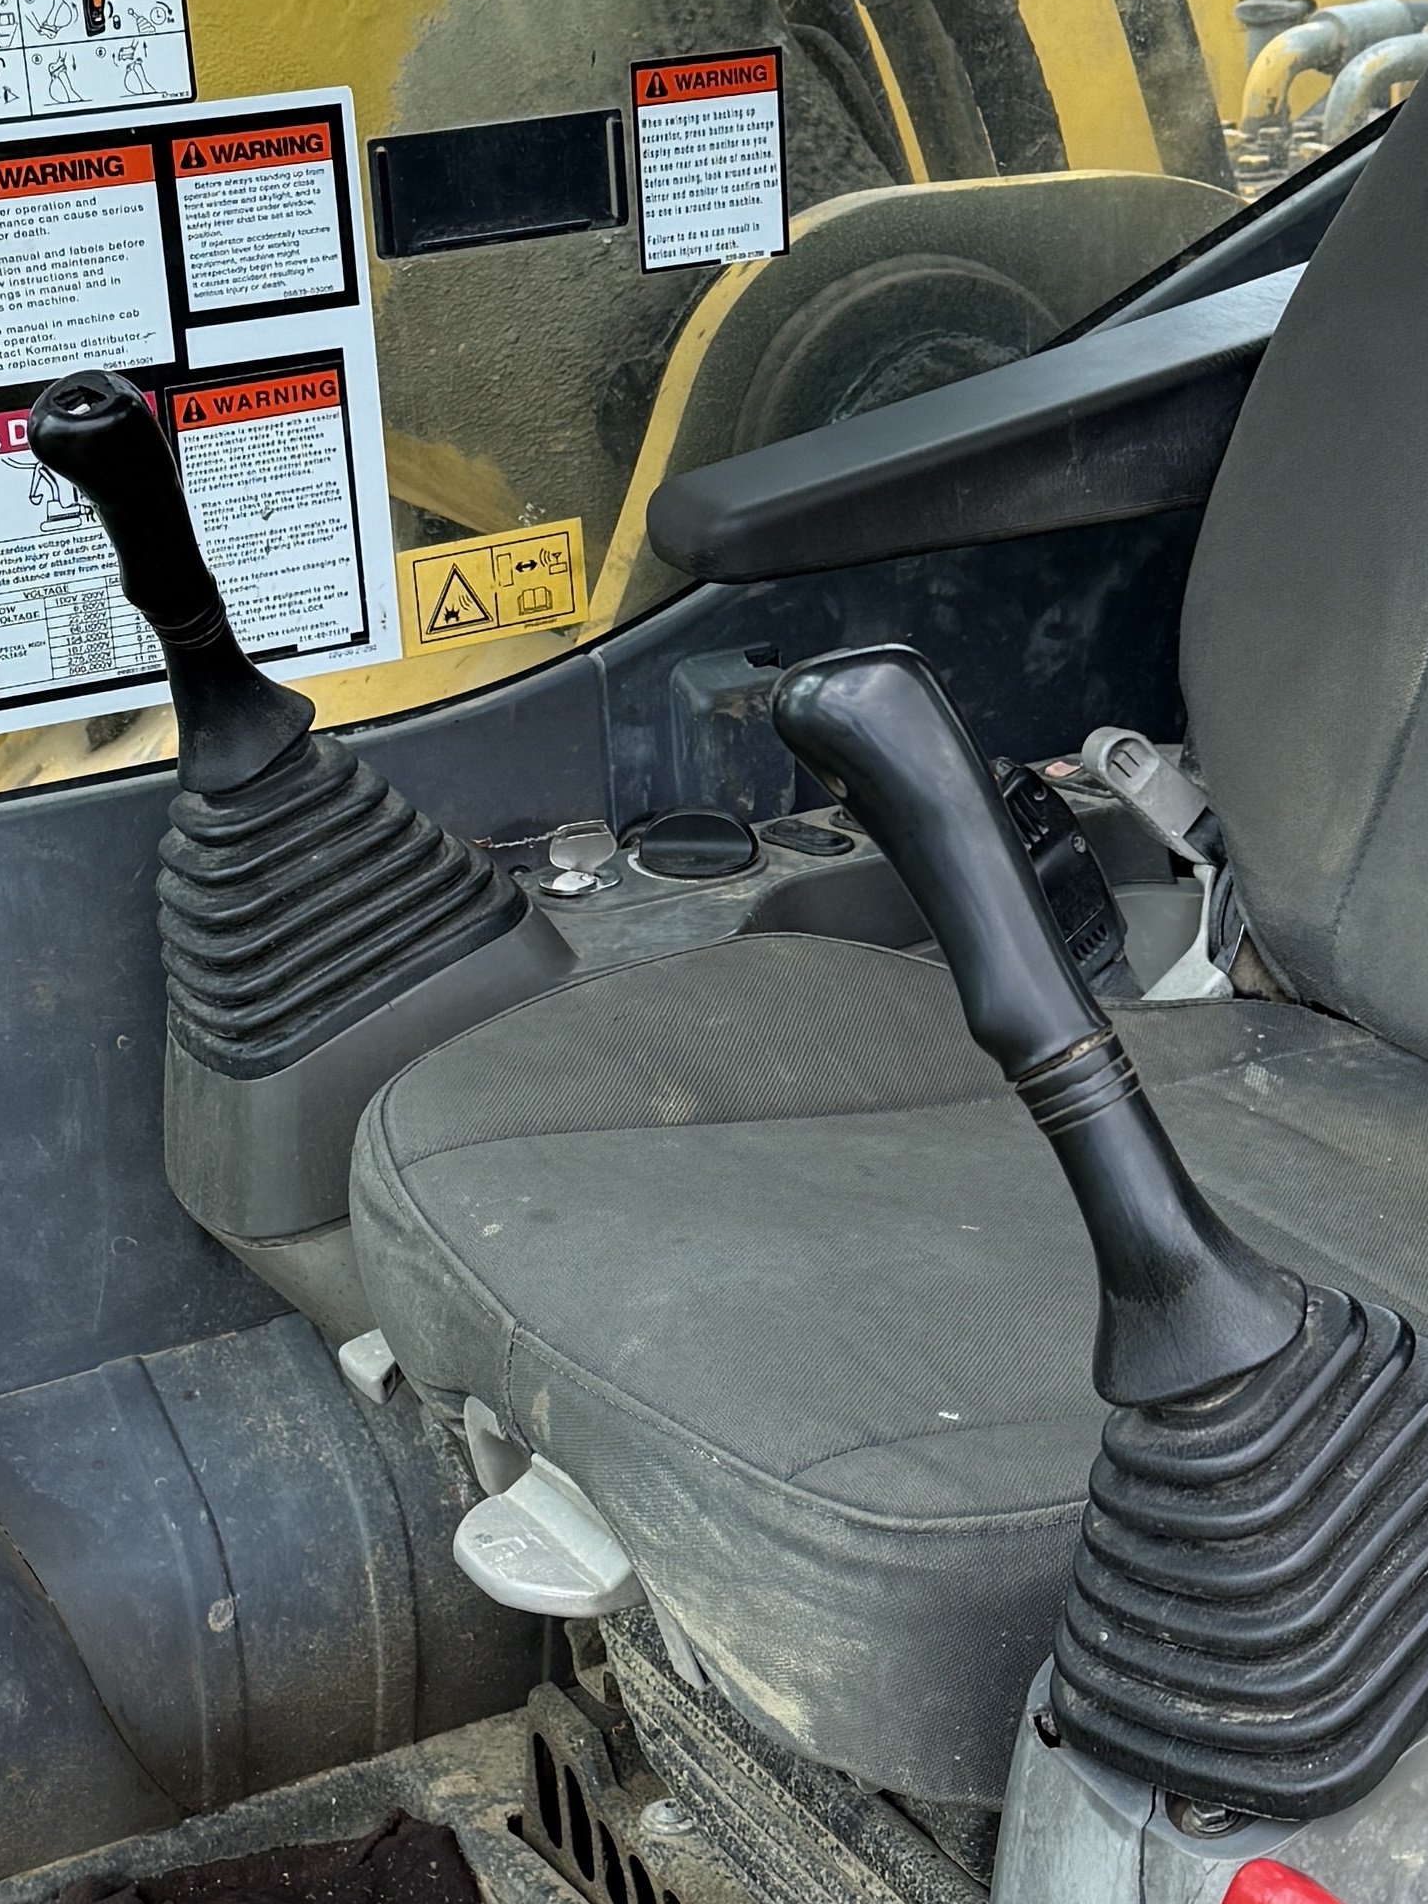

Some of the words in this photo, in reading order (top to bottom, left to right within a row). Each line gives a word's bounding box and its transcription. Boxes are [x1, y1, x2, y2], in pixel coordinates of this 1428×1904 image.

[675, 65, 767, 91] WARNING
[210, 134, 324, 164] WARNING
[16, 201, 71, 215] operation
[76, 197, 96, 207] and
[39, 214, 59, 223] can
[64, 210, 98, 220] cause
[102, 204, 144, 216] serious
[212, 380, 336, 414] WARNING
